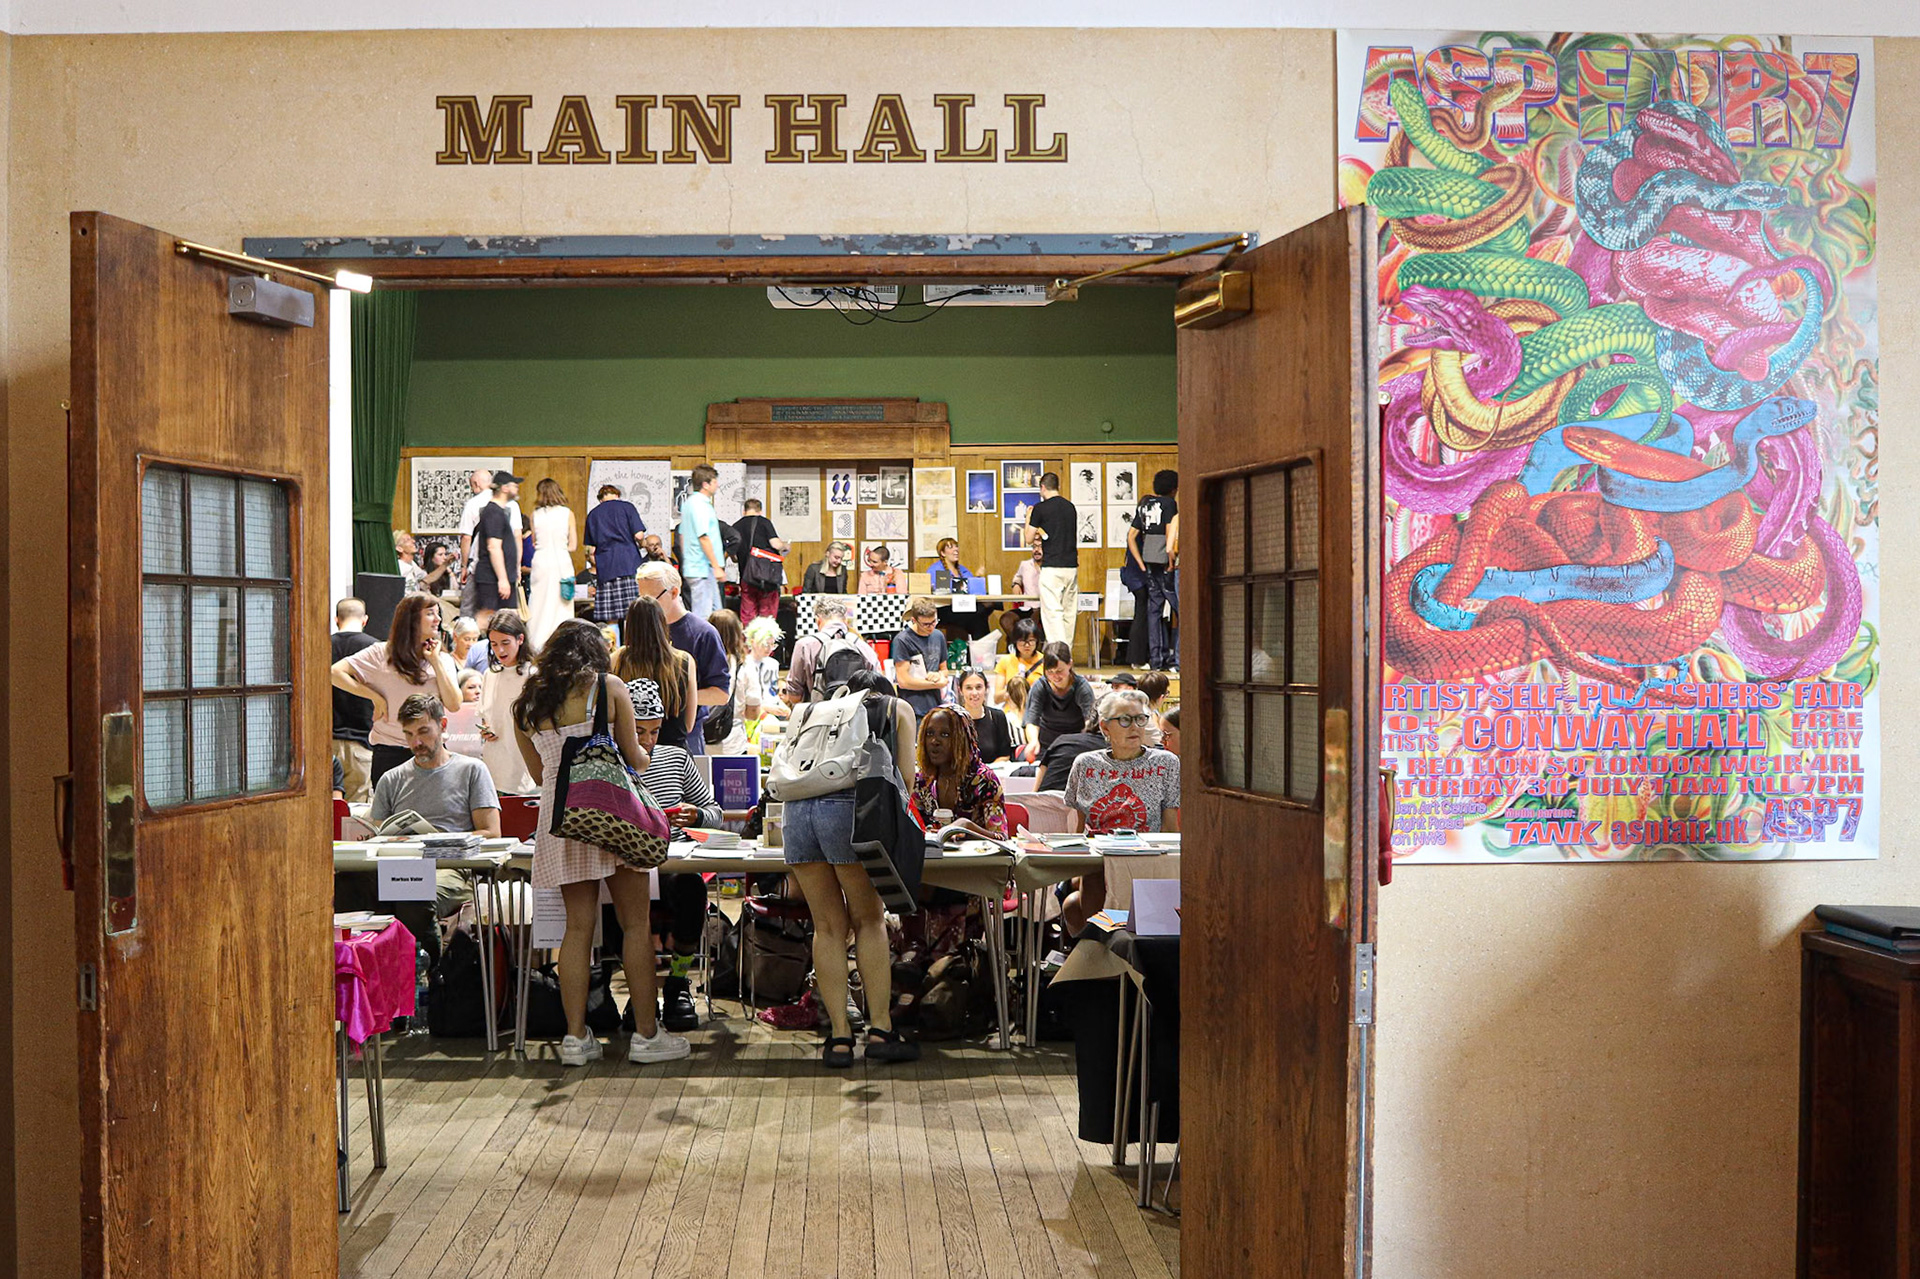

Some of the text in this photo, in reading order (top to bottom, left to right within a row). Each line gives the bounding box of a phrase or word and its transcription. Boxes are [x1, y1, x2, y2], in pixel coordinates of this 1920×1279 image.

[1355, 46, 1860, 149] ASP FAIR 7
[435, 93, 1069, 165] MAIN HALL
[614, 470, 629, 480] the
[630, 470, 654, 482] home
[655, 478, 667, 490] of
[718, 478, 739, 495] From
[1794, 682, 1864, 710] FAIR
[1382, 714, 1440, 734] 0+
[1791, 711, 1864, 730] FREE
[1461, 713, 1766, 751] CONWAY HALL
[1790, 731, 1863, 749] ENTRY
[1381, 733, 1440, 752] TISTS
[1407, 757, 1464, 777] RED
[1472, 756, 1539, 777] LION
[1547, 756, 1586, 776] SQ
[1593, 755, 1713, 776] LONDON
[1719, 754, 1803, 775] WC1R
[1810, 754, 1865, 774] 4RL
[731, 787, 751, 795] THE
[1527, 777, 1569, 797] 30
[1576, 777, 1643, 797] JULY
[1652, 776, 1729, 796] 11AM
[1736, 775, 1795, 795] TILL
[1801, 775, 1864, 794] 7PM
[1418, 800, 1440, 815] Art
[1441, 799, 1487, 816] Centre
[1504, 808, 1576, 819] Media partner:
[1428, 816, 1464, 831] Road
[1762, 797, 1864, 843] ASP7
[1413, 831, 1446, 846] NW3
[1505, 821, 1602, 846] TANK
[1610, 815, 1749, 846] aspfair.uk
